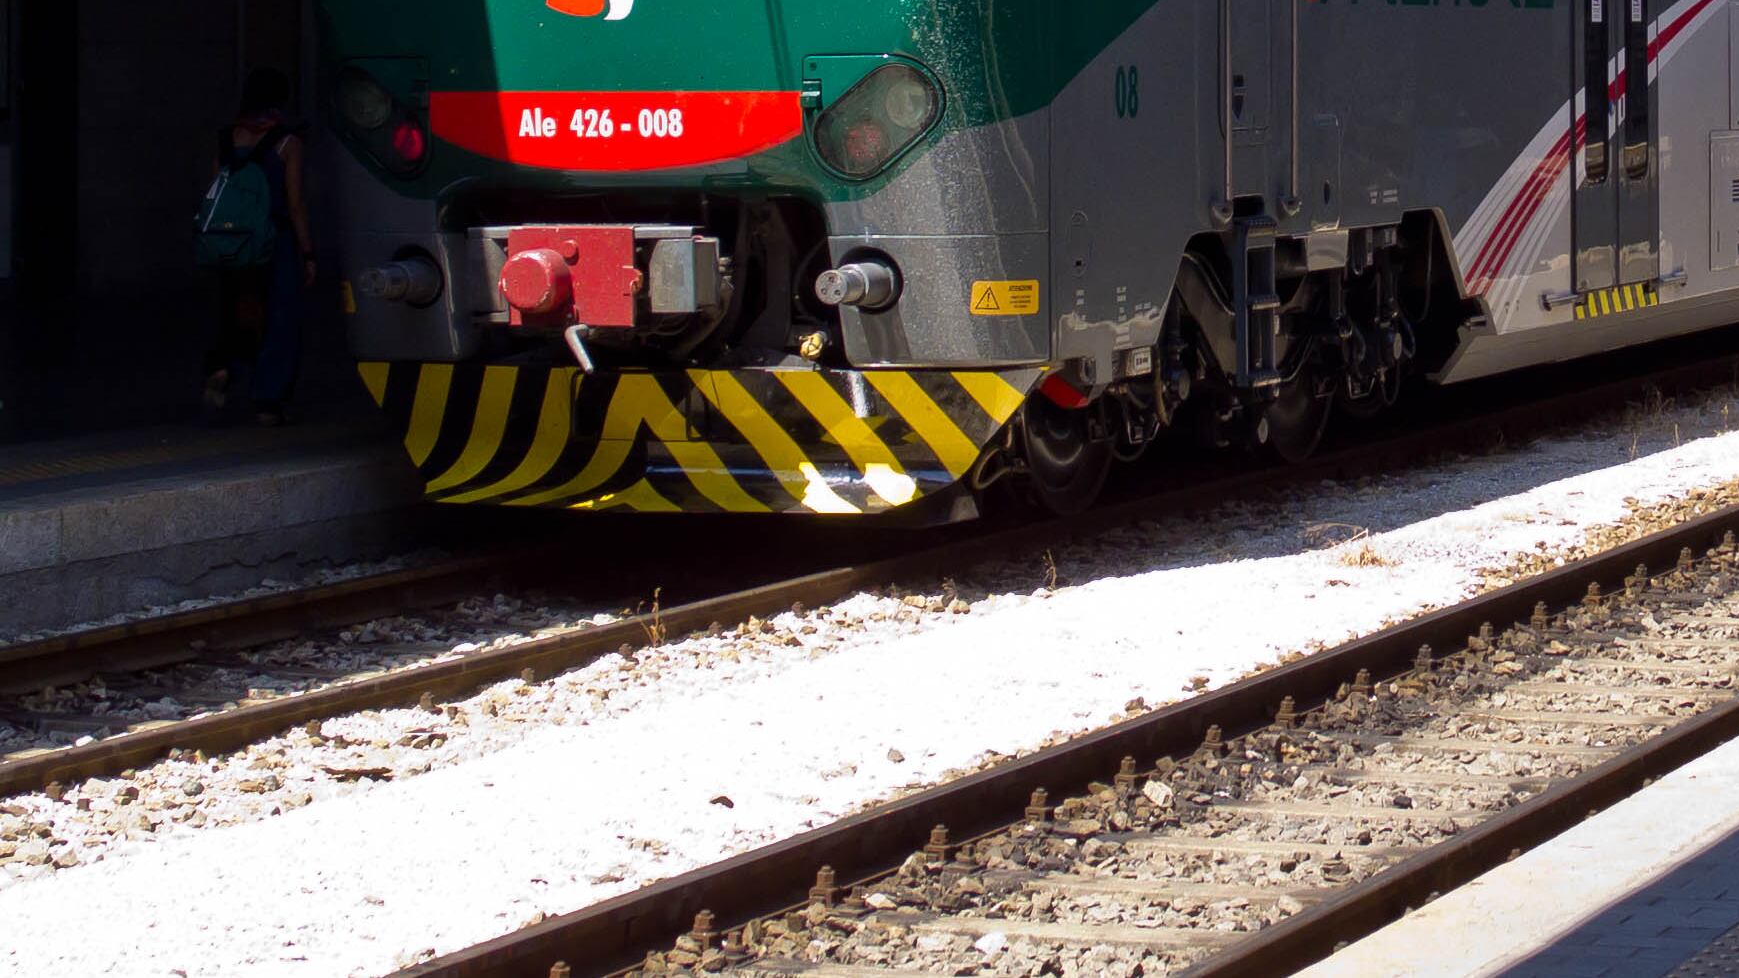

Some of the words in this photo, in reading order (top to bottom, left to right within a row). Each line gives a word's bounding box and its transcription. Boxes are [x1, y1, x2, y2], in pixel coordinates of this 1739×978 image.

[1115, 65, 1139, 119] 08
[518, 108, 557, 138] Ale
[569, 108, 614, 138] 426
[620, 123, 632, 132] -
[637, 108, 684, 138] 008
